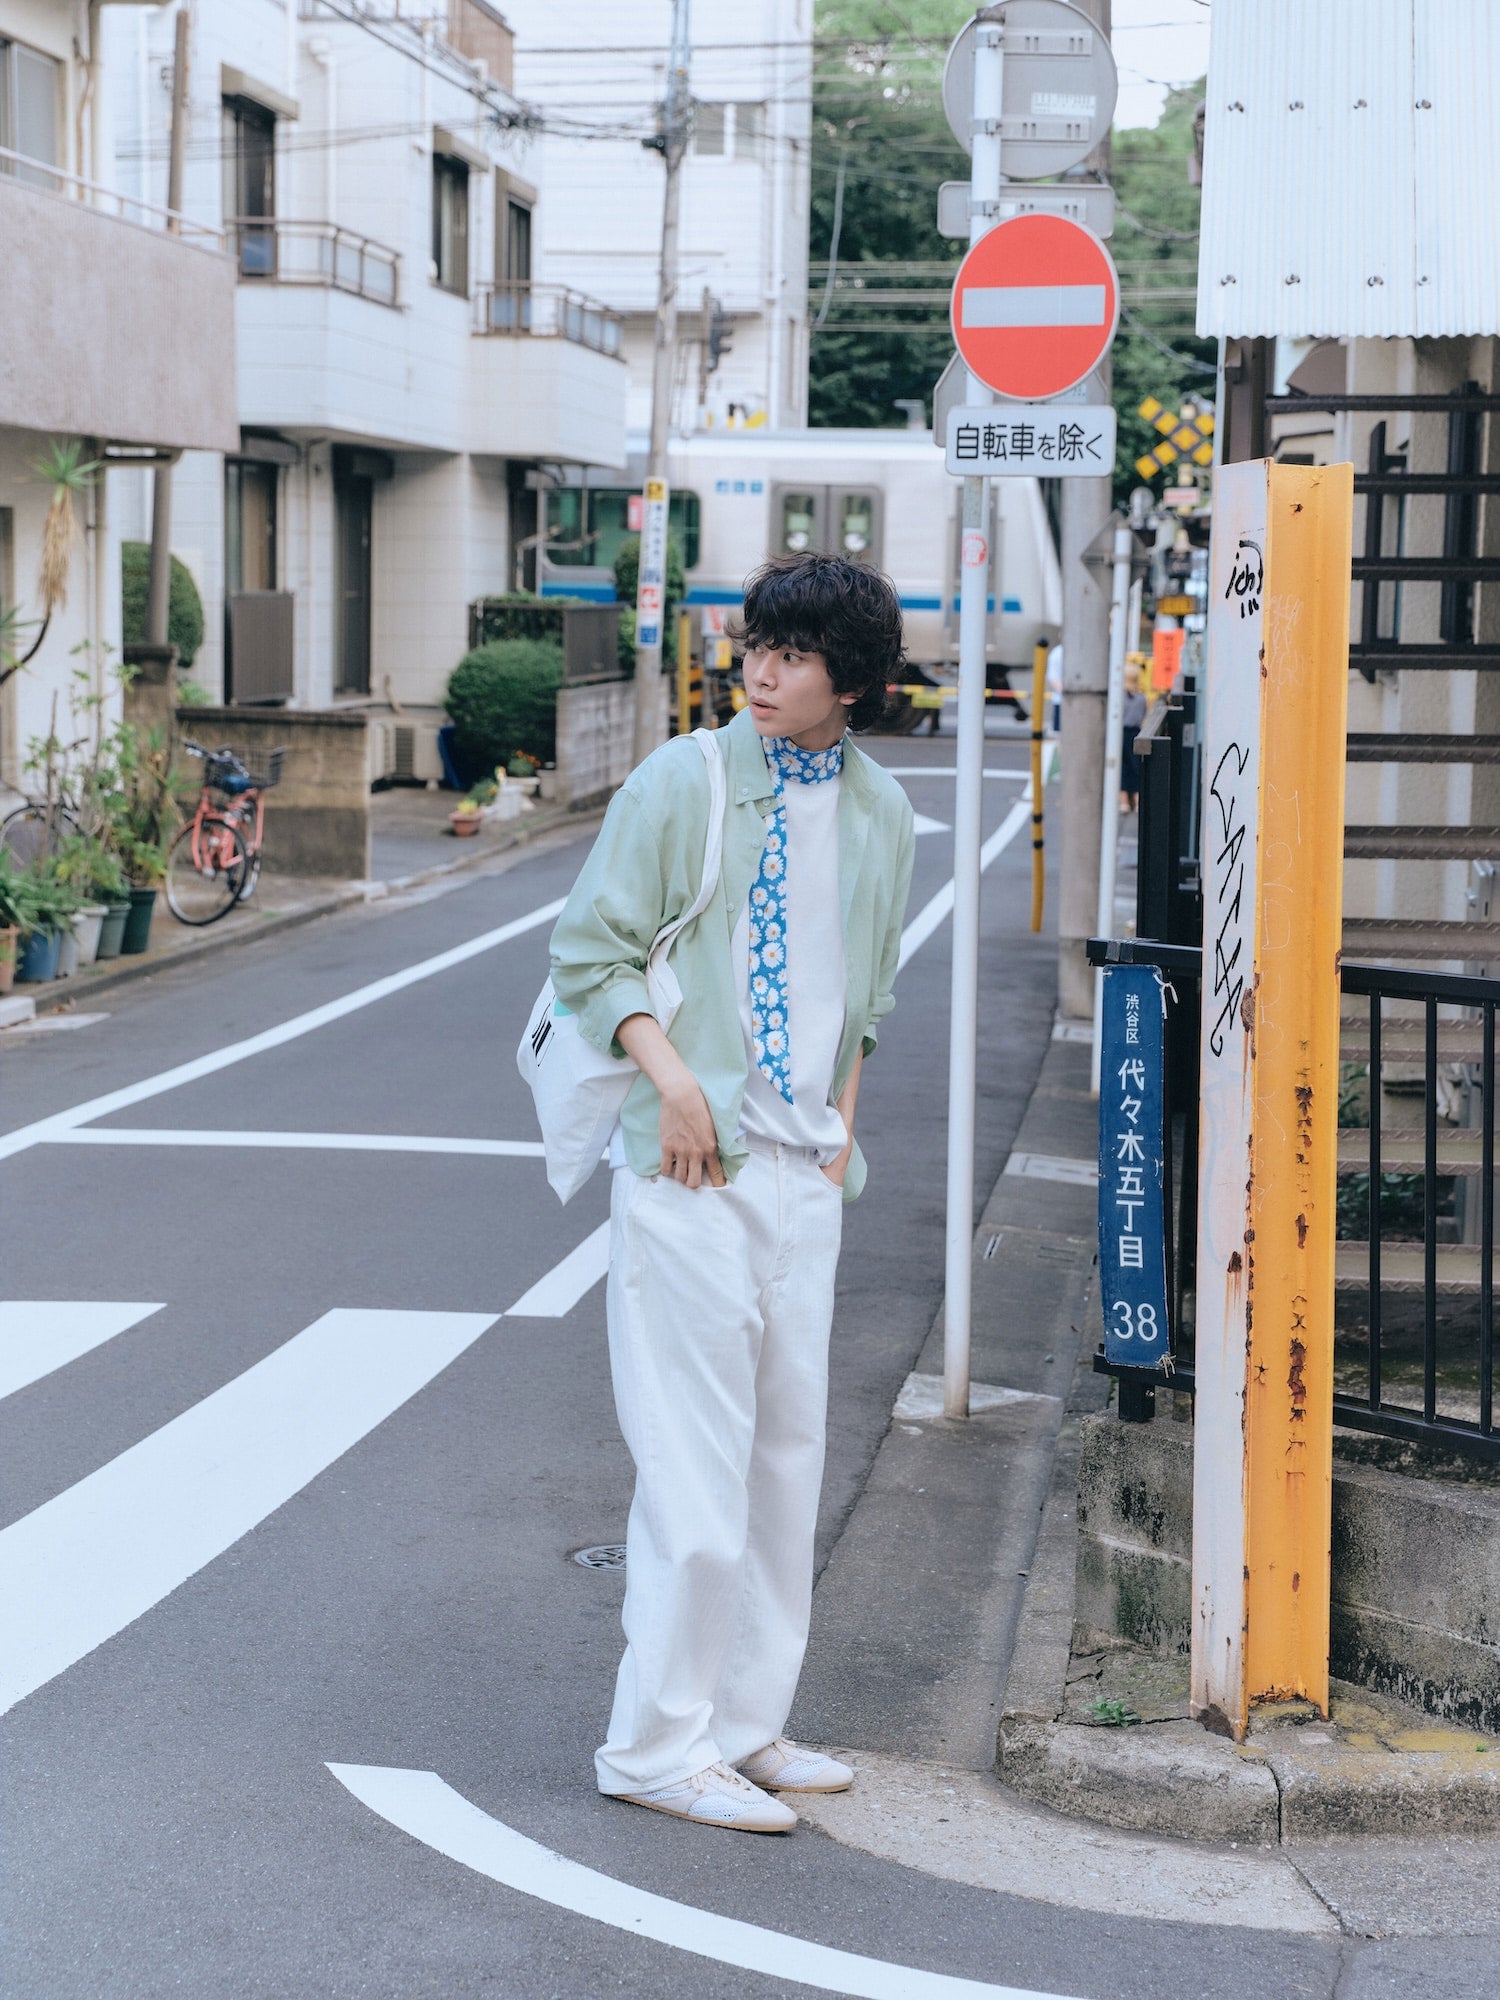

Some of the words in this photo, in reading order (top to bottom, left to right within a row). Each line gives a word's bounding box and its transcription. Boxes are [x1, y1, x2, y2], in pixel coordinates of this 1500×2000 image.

[956, 422, 1102, 461] 自転車を除く
[1125, 993, 1140, 1044] 渋谷区
[1116, 1058, 1146, 1269] 代々木五丁目
[1112, 1300, 1158, 1342] 38
